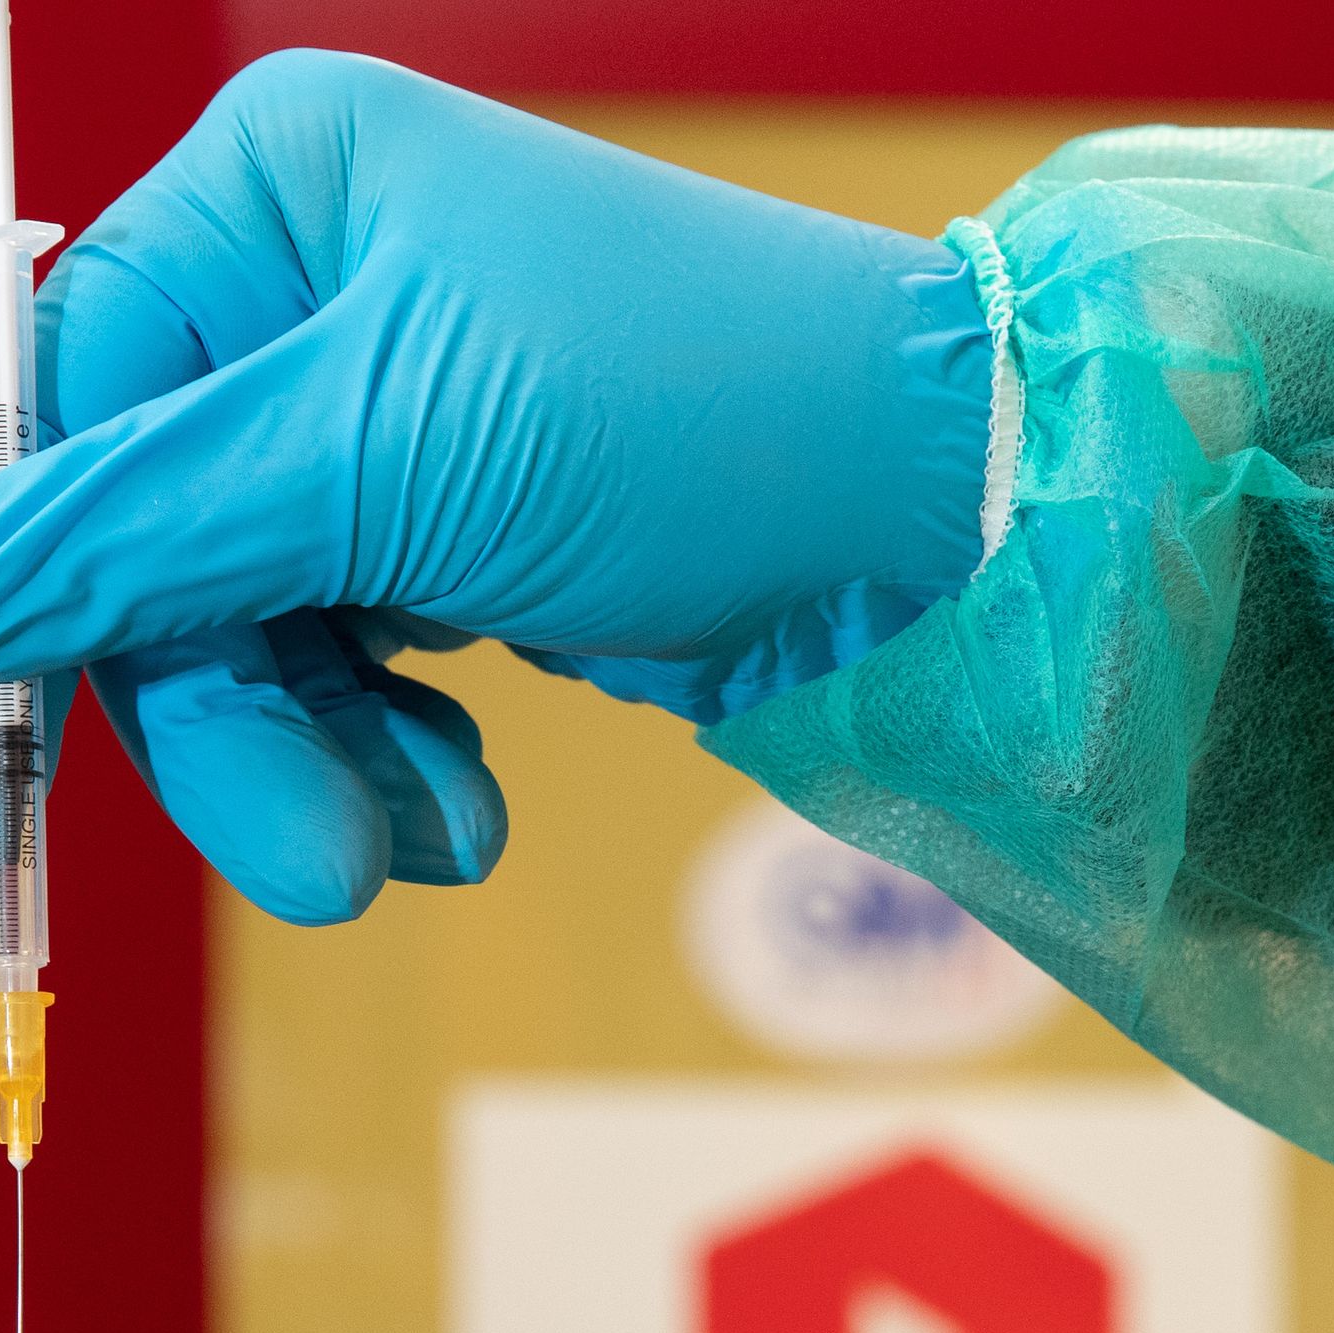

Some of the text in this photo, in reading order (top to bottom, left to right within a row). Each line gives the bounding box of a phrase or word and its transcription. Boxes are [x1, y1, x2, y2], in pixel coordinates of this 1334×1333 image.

[18, 679, 37, 869] SINGLE USE ONLY
